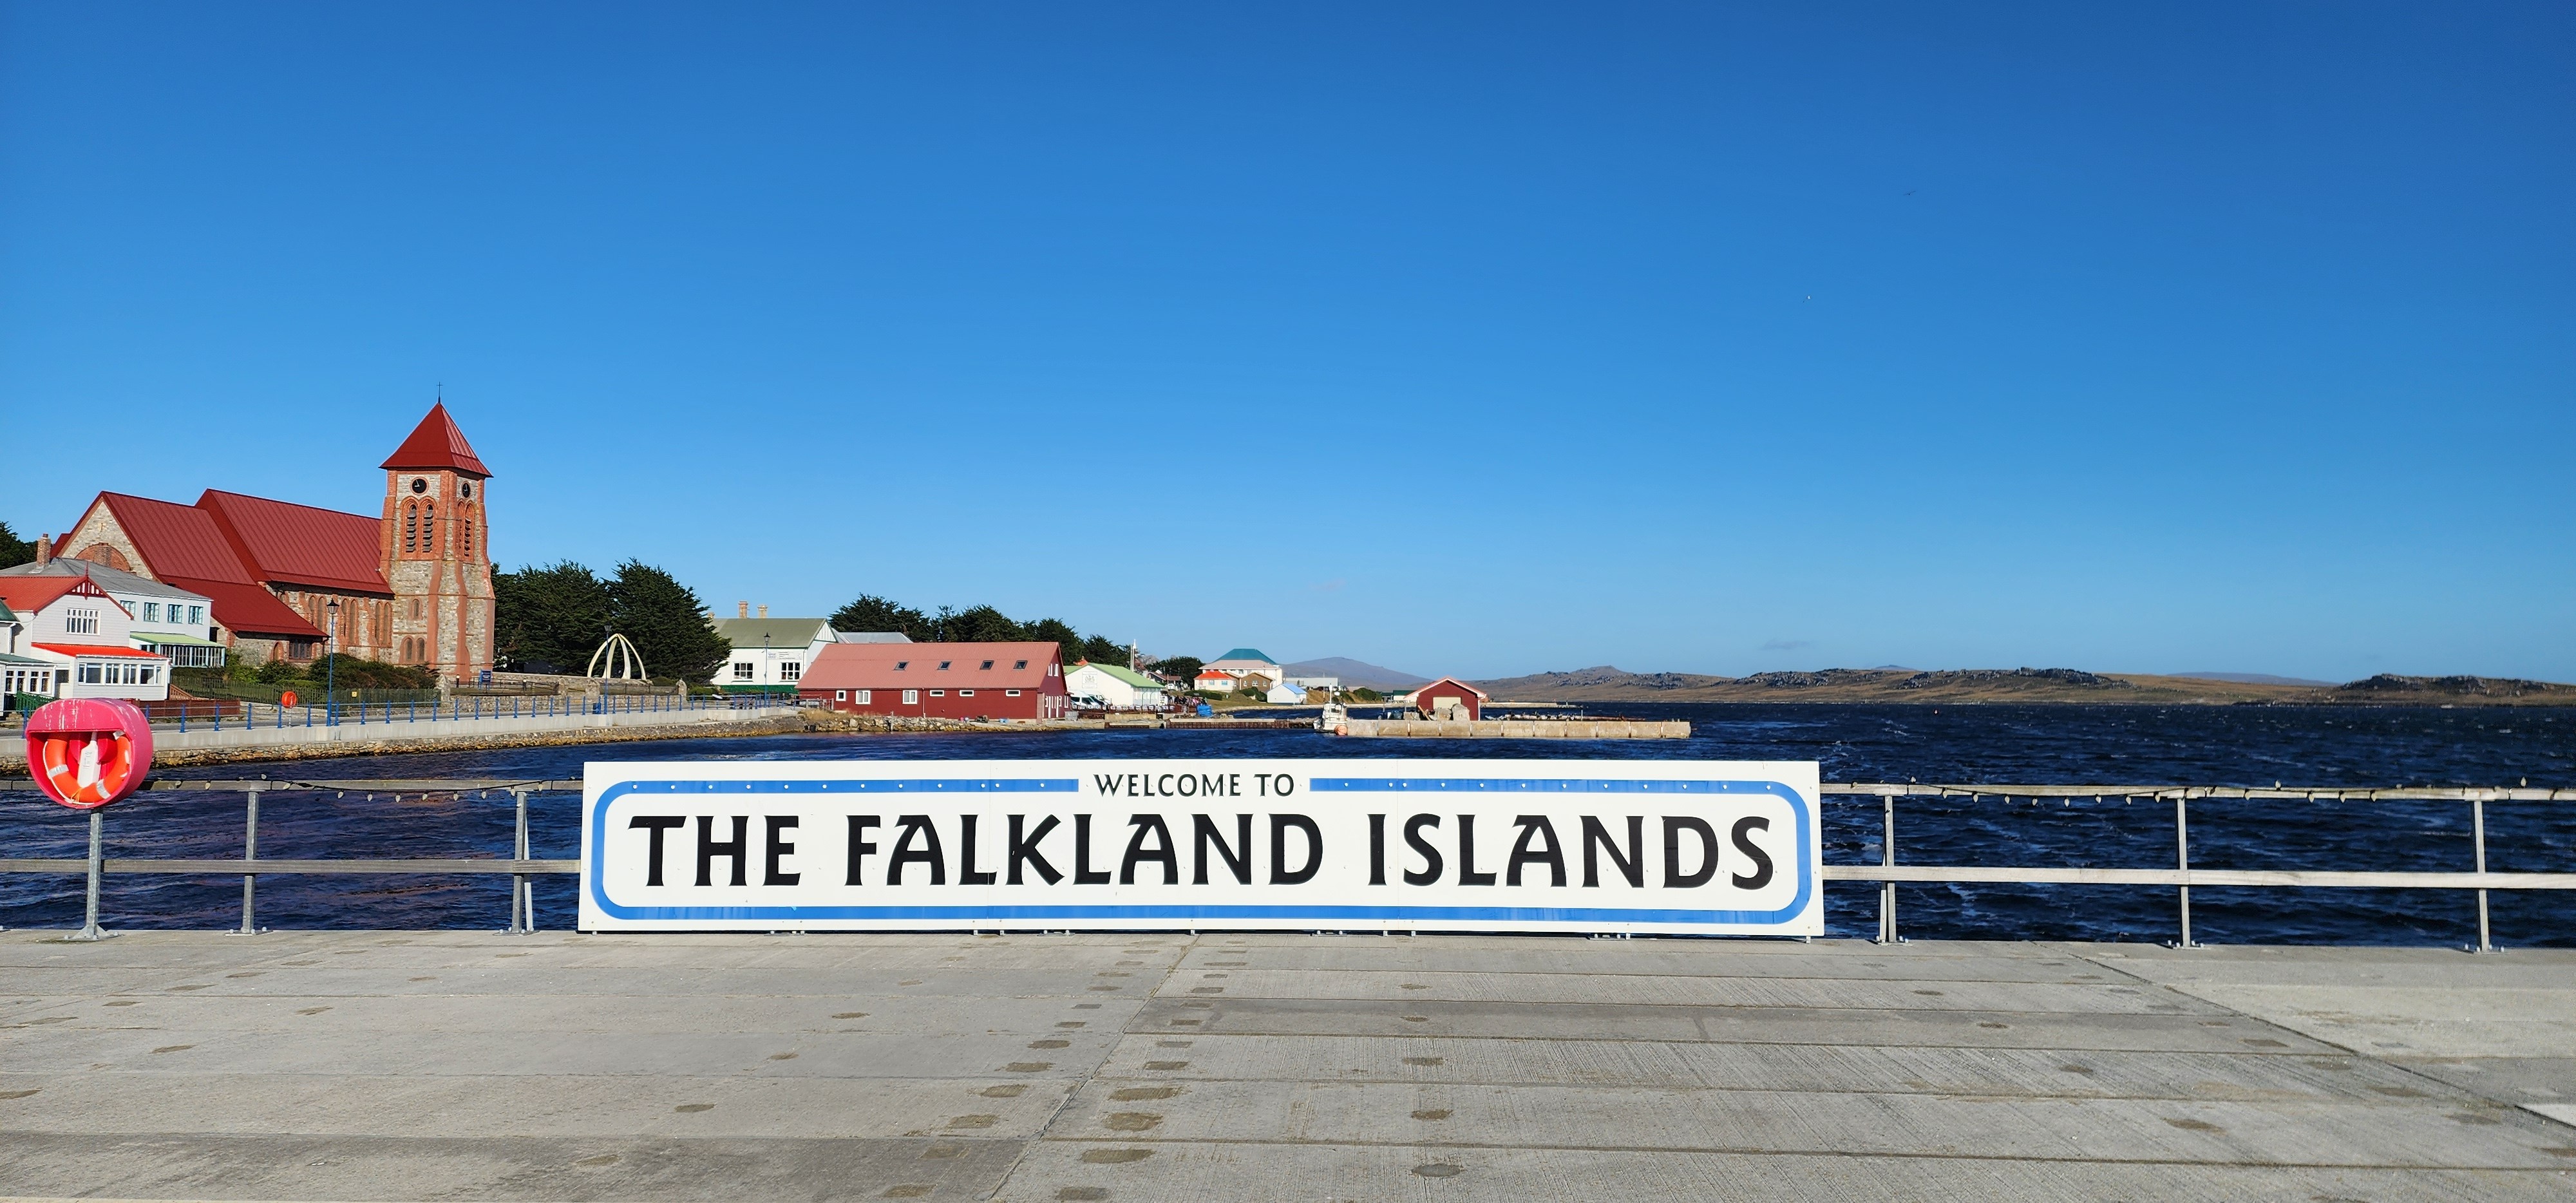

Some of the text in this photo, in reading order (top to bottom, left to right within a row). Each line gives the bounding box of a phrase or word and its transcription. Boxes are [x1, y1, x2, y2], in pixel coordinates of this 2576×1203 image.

[1094, 773, 1294, 797] WELCOME TO
[629, 813, 1774, 890] THE FALKLAND ISLANDS
